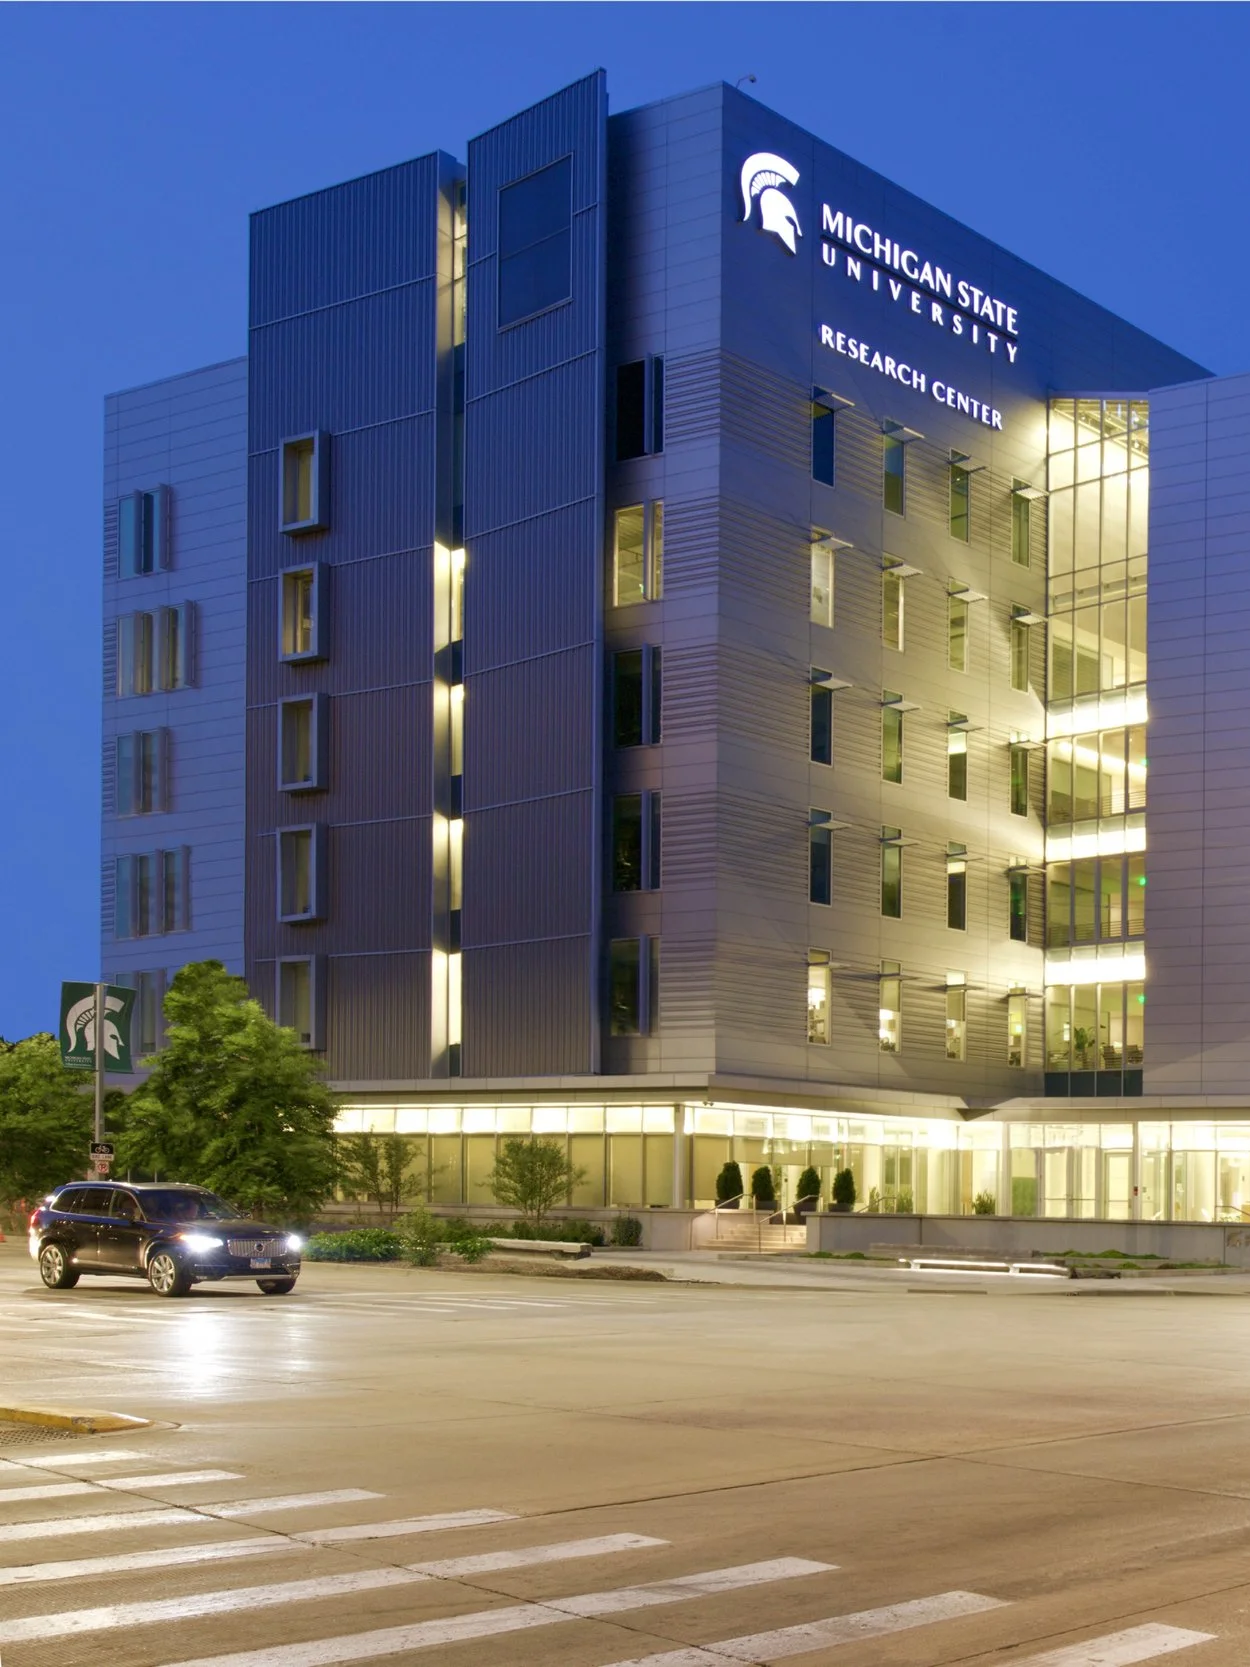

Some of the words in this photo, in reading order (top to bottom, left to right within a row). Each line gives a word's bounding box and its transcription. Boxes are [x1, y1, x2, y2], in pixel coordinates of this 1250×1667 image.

[822, 203, 951, 298] MICHIGAN
[957, 280, 1019, 335] STATE
[822, 242, 1018, 363] UNIVERSITY
[821, 324, 926, 393] RESEARCH
[931, 381, 1004, 431] CENTER
